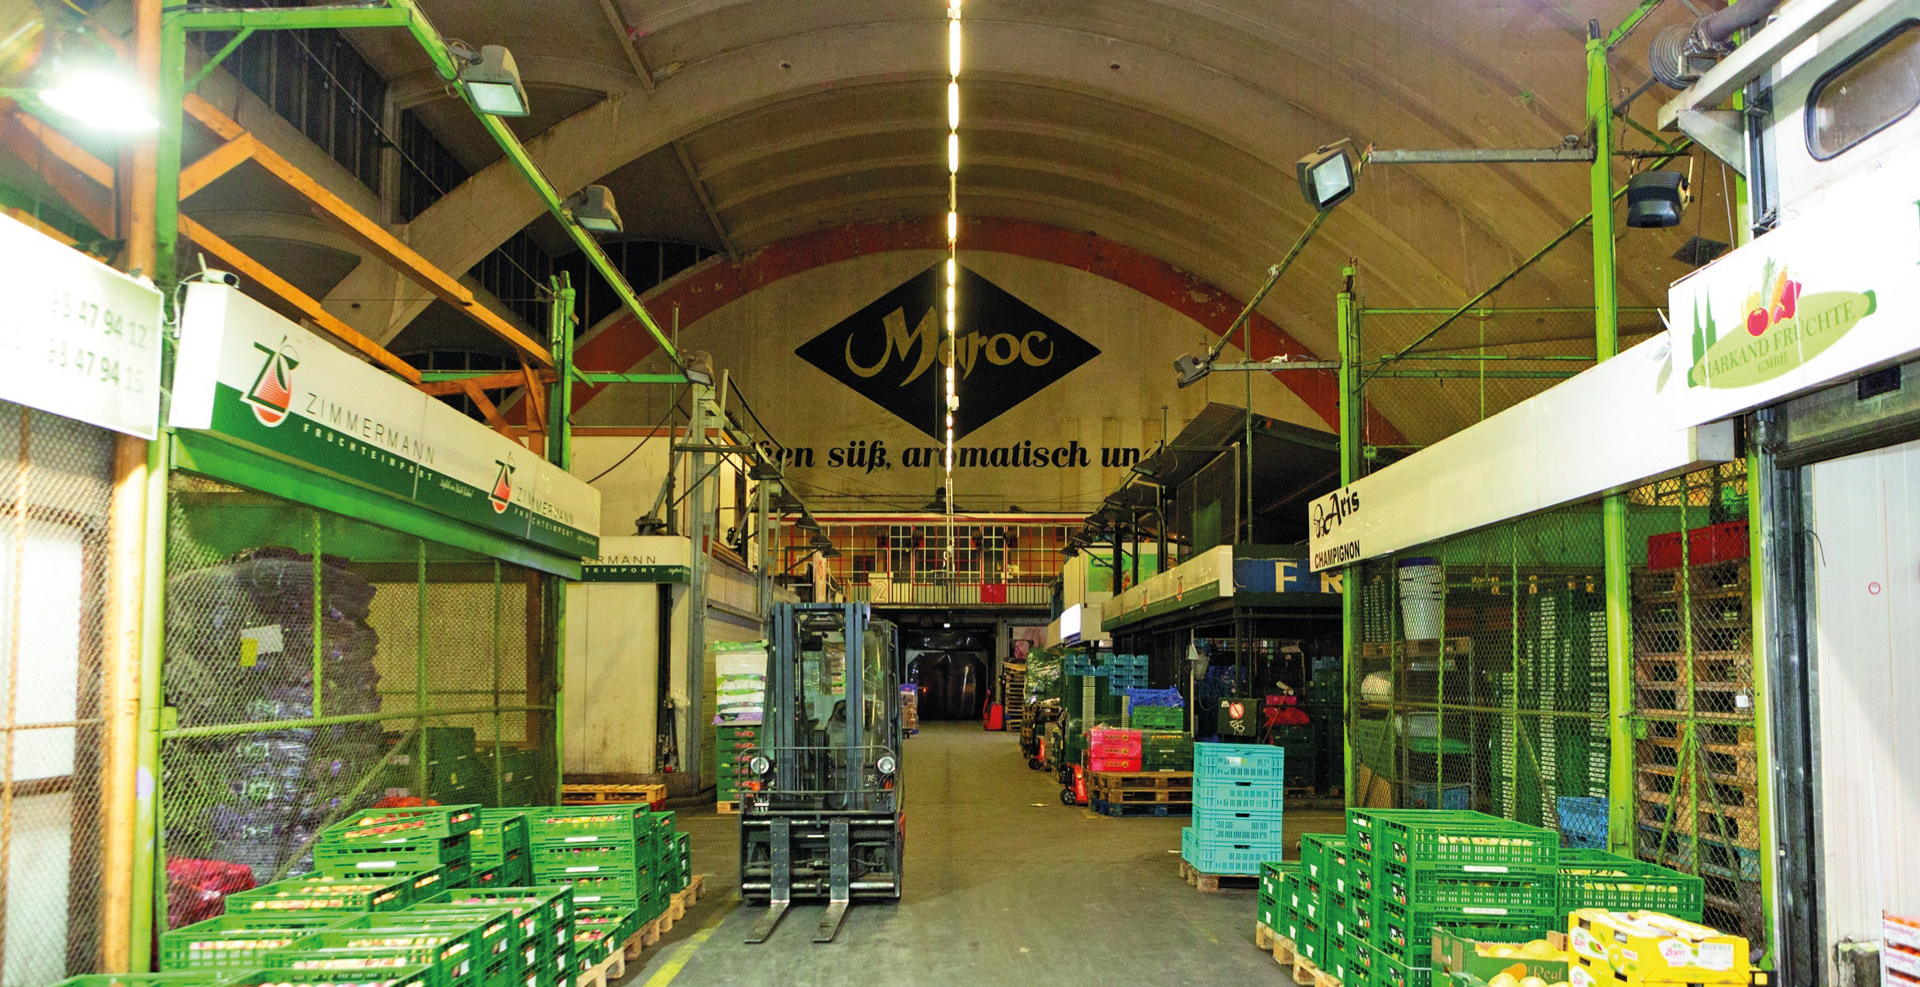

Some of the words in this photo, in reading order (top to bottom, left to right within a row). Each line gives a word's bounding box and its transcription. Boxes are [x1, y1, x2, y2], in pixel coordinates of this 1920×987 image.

[78, 301, 99, 330] 47
[104, 310, 123, 337] 94
[129, 320, 147, 350] 12
[845, 305, 1053, 387] Maroc
[1700, 341, 1769, 381] MARKAND
[1757, 352, 1788, 373] GMBH
[75, 349, 96, 377] 47
[100, 357, 120, 388] 94
[306, 392, 434, 464] ZIMMERMANN
[303, 423, 433, 481] FRÜCHTEIMPORT
[828, 440, 891, 475] süß,
[902, 439, 1091, 468] aromatisch
[517, 487, 574, 526] ZIMMERMANN
[582, 555, 656, 565] RMANN
[1314, 539, 1361, 569] CHAMPIGNON
[873, 582, 887, 602] 2
[1528, 965, 1563, 980] Real
